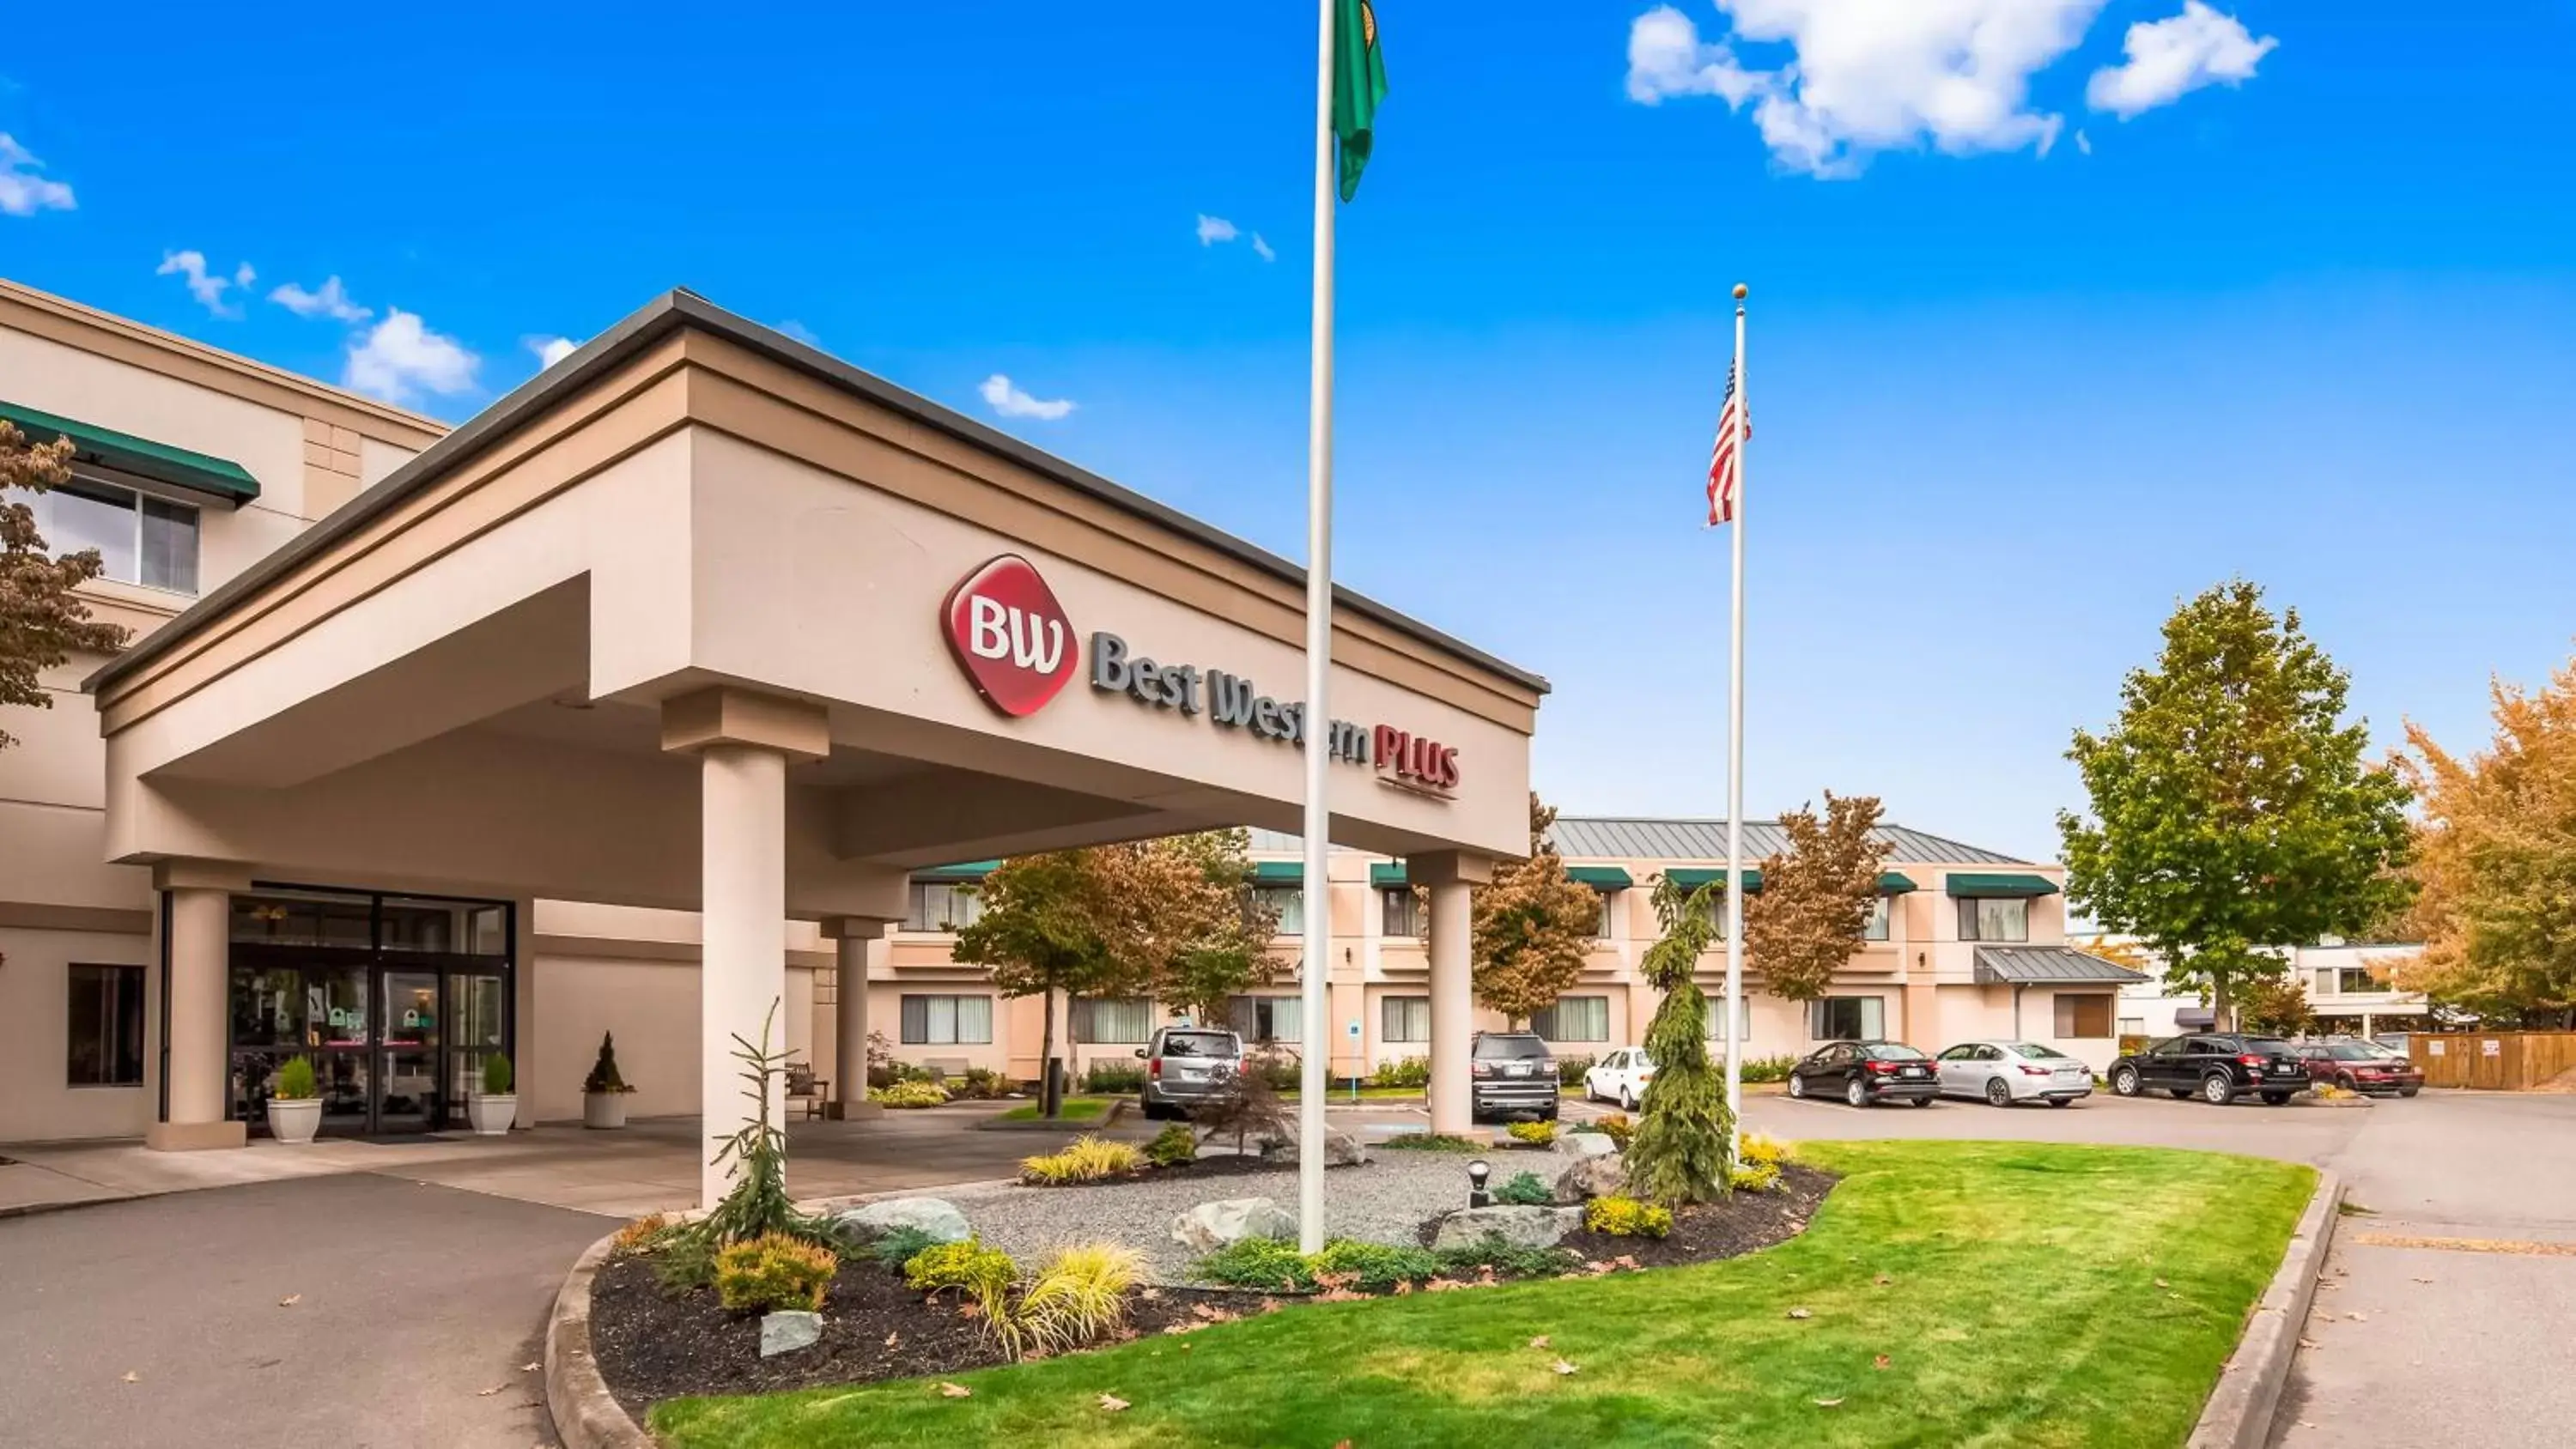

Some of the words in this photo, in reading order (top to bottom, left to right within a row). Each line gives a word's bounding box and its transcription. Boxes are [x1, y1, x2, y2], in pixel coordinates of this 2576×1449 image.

[970, 594, 1064, 675] BW
[1091, 631, 1203, 715] Best
[1206, 669, 1370, 764] Westrn
